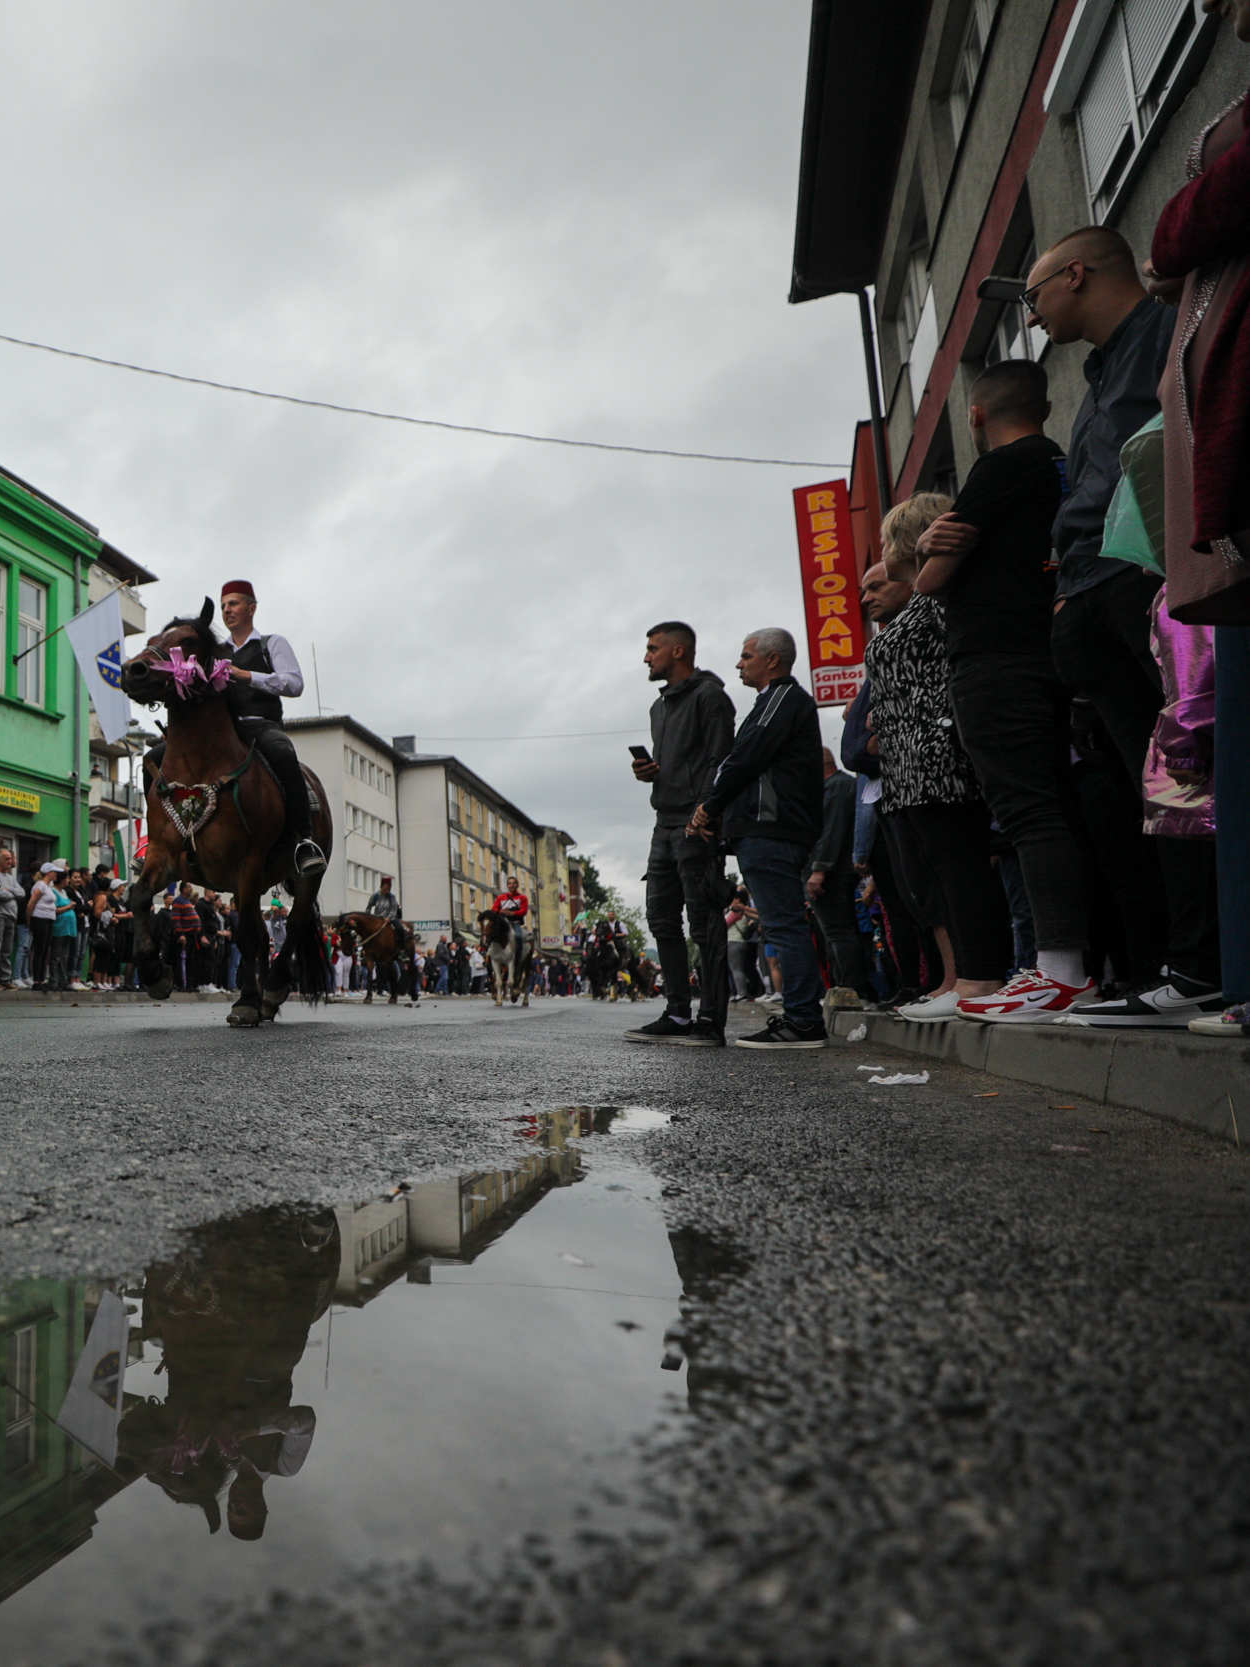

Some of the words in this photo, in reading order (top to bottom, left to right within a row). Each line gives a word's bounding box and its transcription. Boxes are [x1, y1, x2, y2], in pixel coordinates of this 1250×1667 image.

[807, 490, 853, 660] RESTORAN
[815, 670, 864, 683] Santos
[821, 687, 831, 699] P
